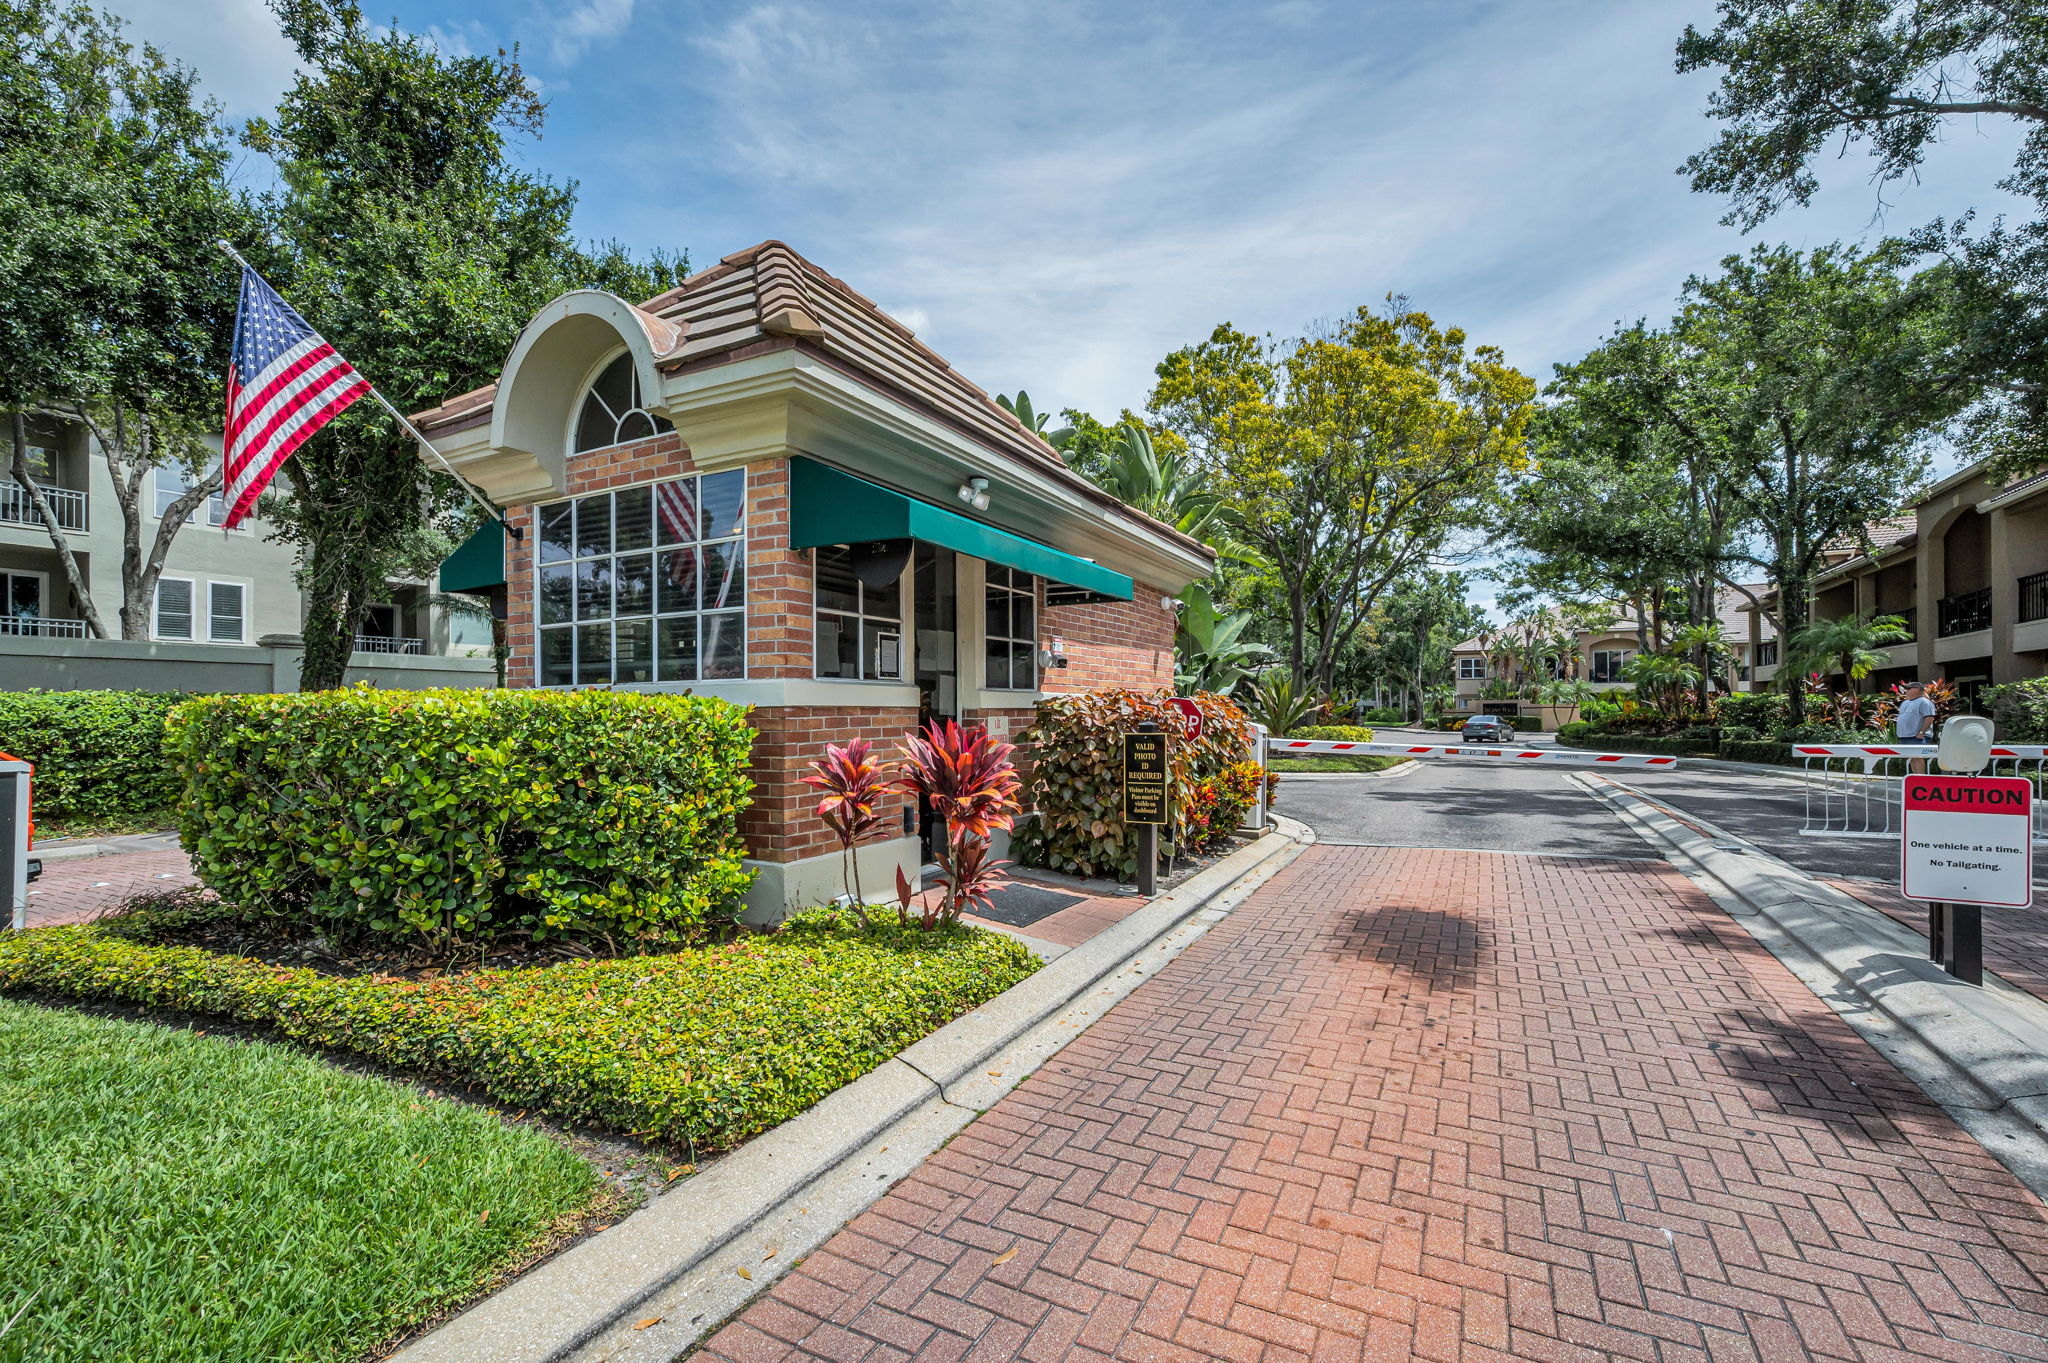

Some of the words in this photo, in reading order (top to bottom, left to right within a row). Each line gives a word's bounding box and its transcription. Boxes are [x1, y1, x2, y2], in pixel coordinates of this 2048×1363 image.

[1134, 752, 1157, 760] PHOTO
[1141, 762, 1150, 770] ID
[1128, 771, 1162, 780] REQUIRED
[1144, 787, 1163, 796] Parking
[1911, 786, 2023, 805] CAUTION
[1910, 840, 1930, 849] One
[1932, 842, 1970, 851] vehicle
[1995, 845, 2023, 854] time.
[1929, 859, 1944, 867] No
[1946, 860, 2002, 872] Tailgating.
